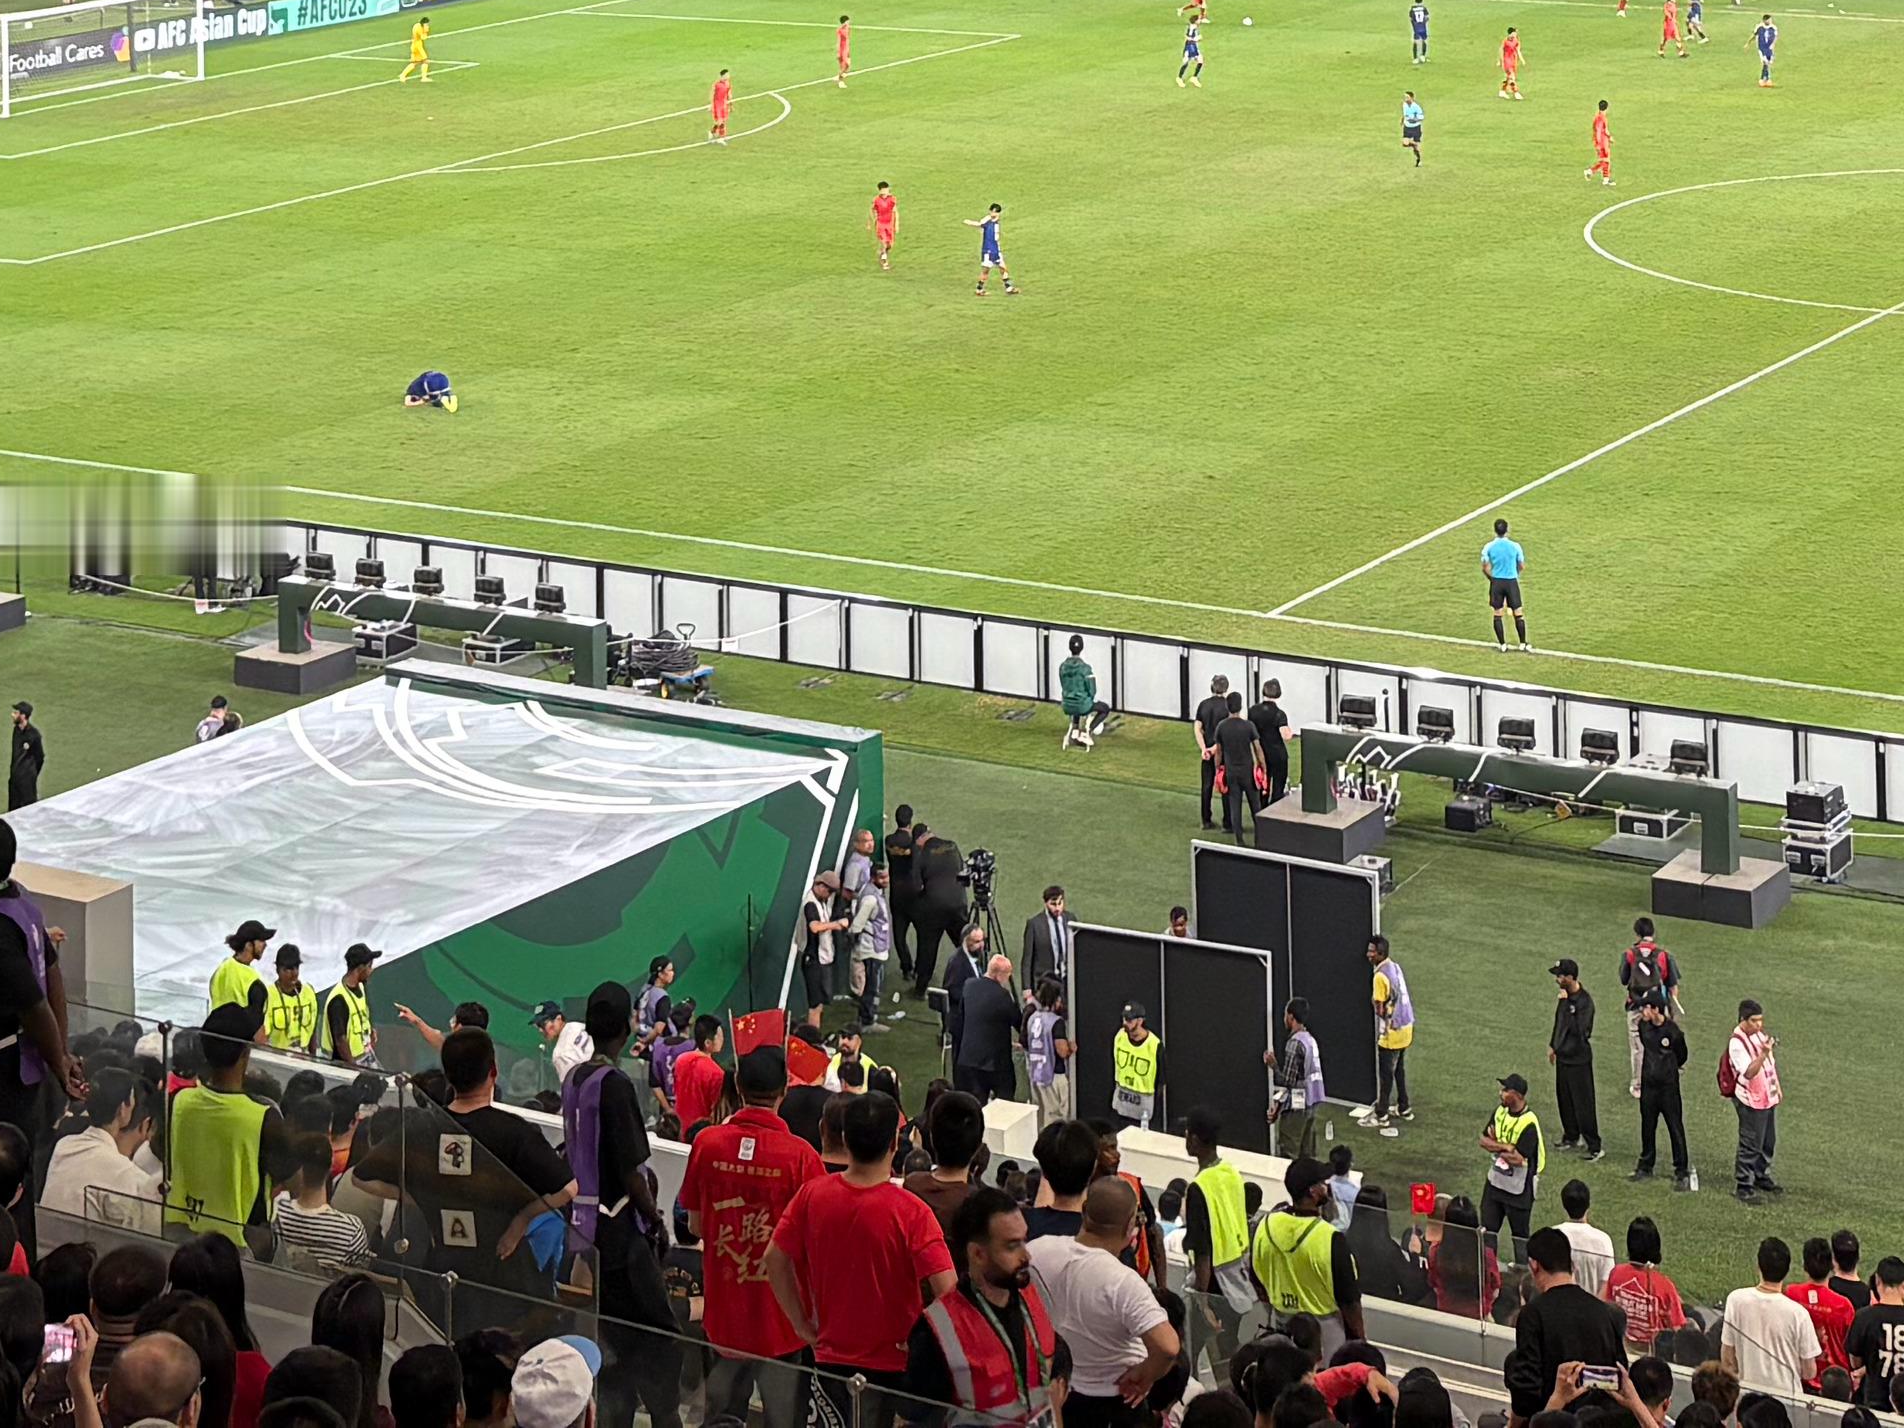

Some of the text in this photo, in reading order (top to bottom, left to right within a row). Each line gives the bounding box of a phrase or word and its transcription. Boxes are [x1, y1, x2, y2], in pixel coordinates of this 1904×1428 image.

[157, 7, 267, 50] AFC Asian Cup
[10, 41, 104, 72] Football Cares
